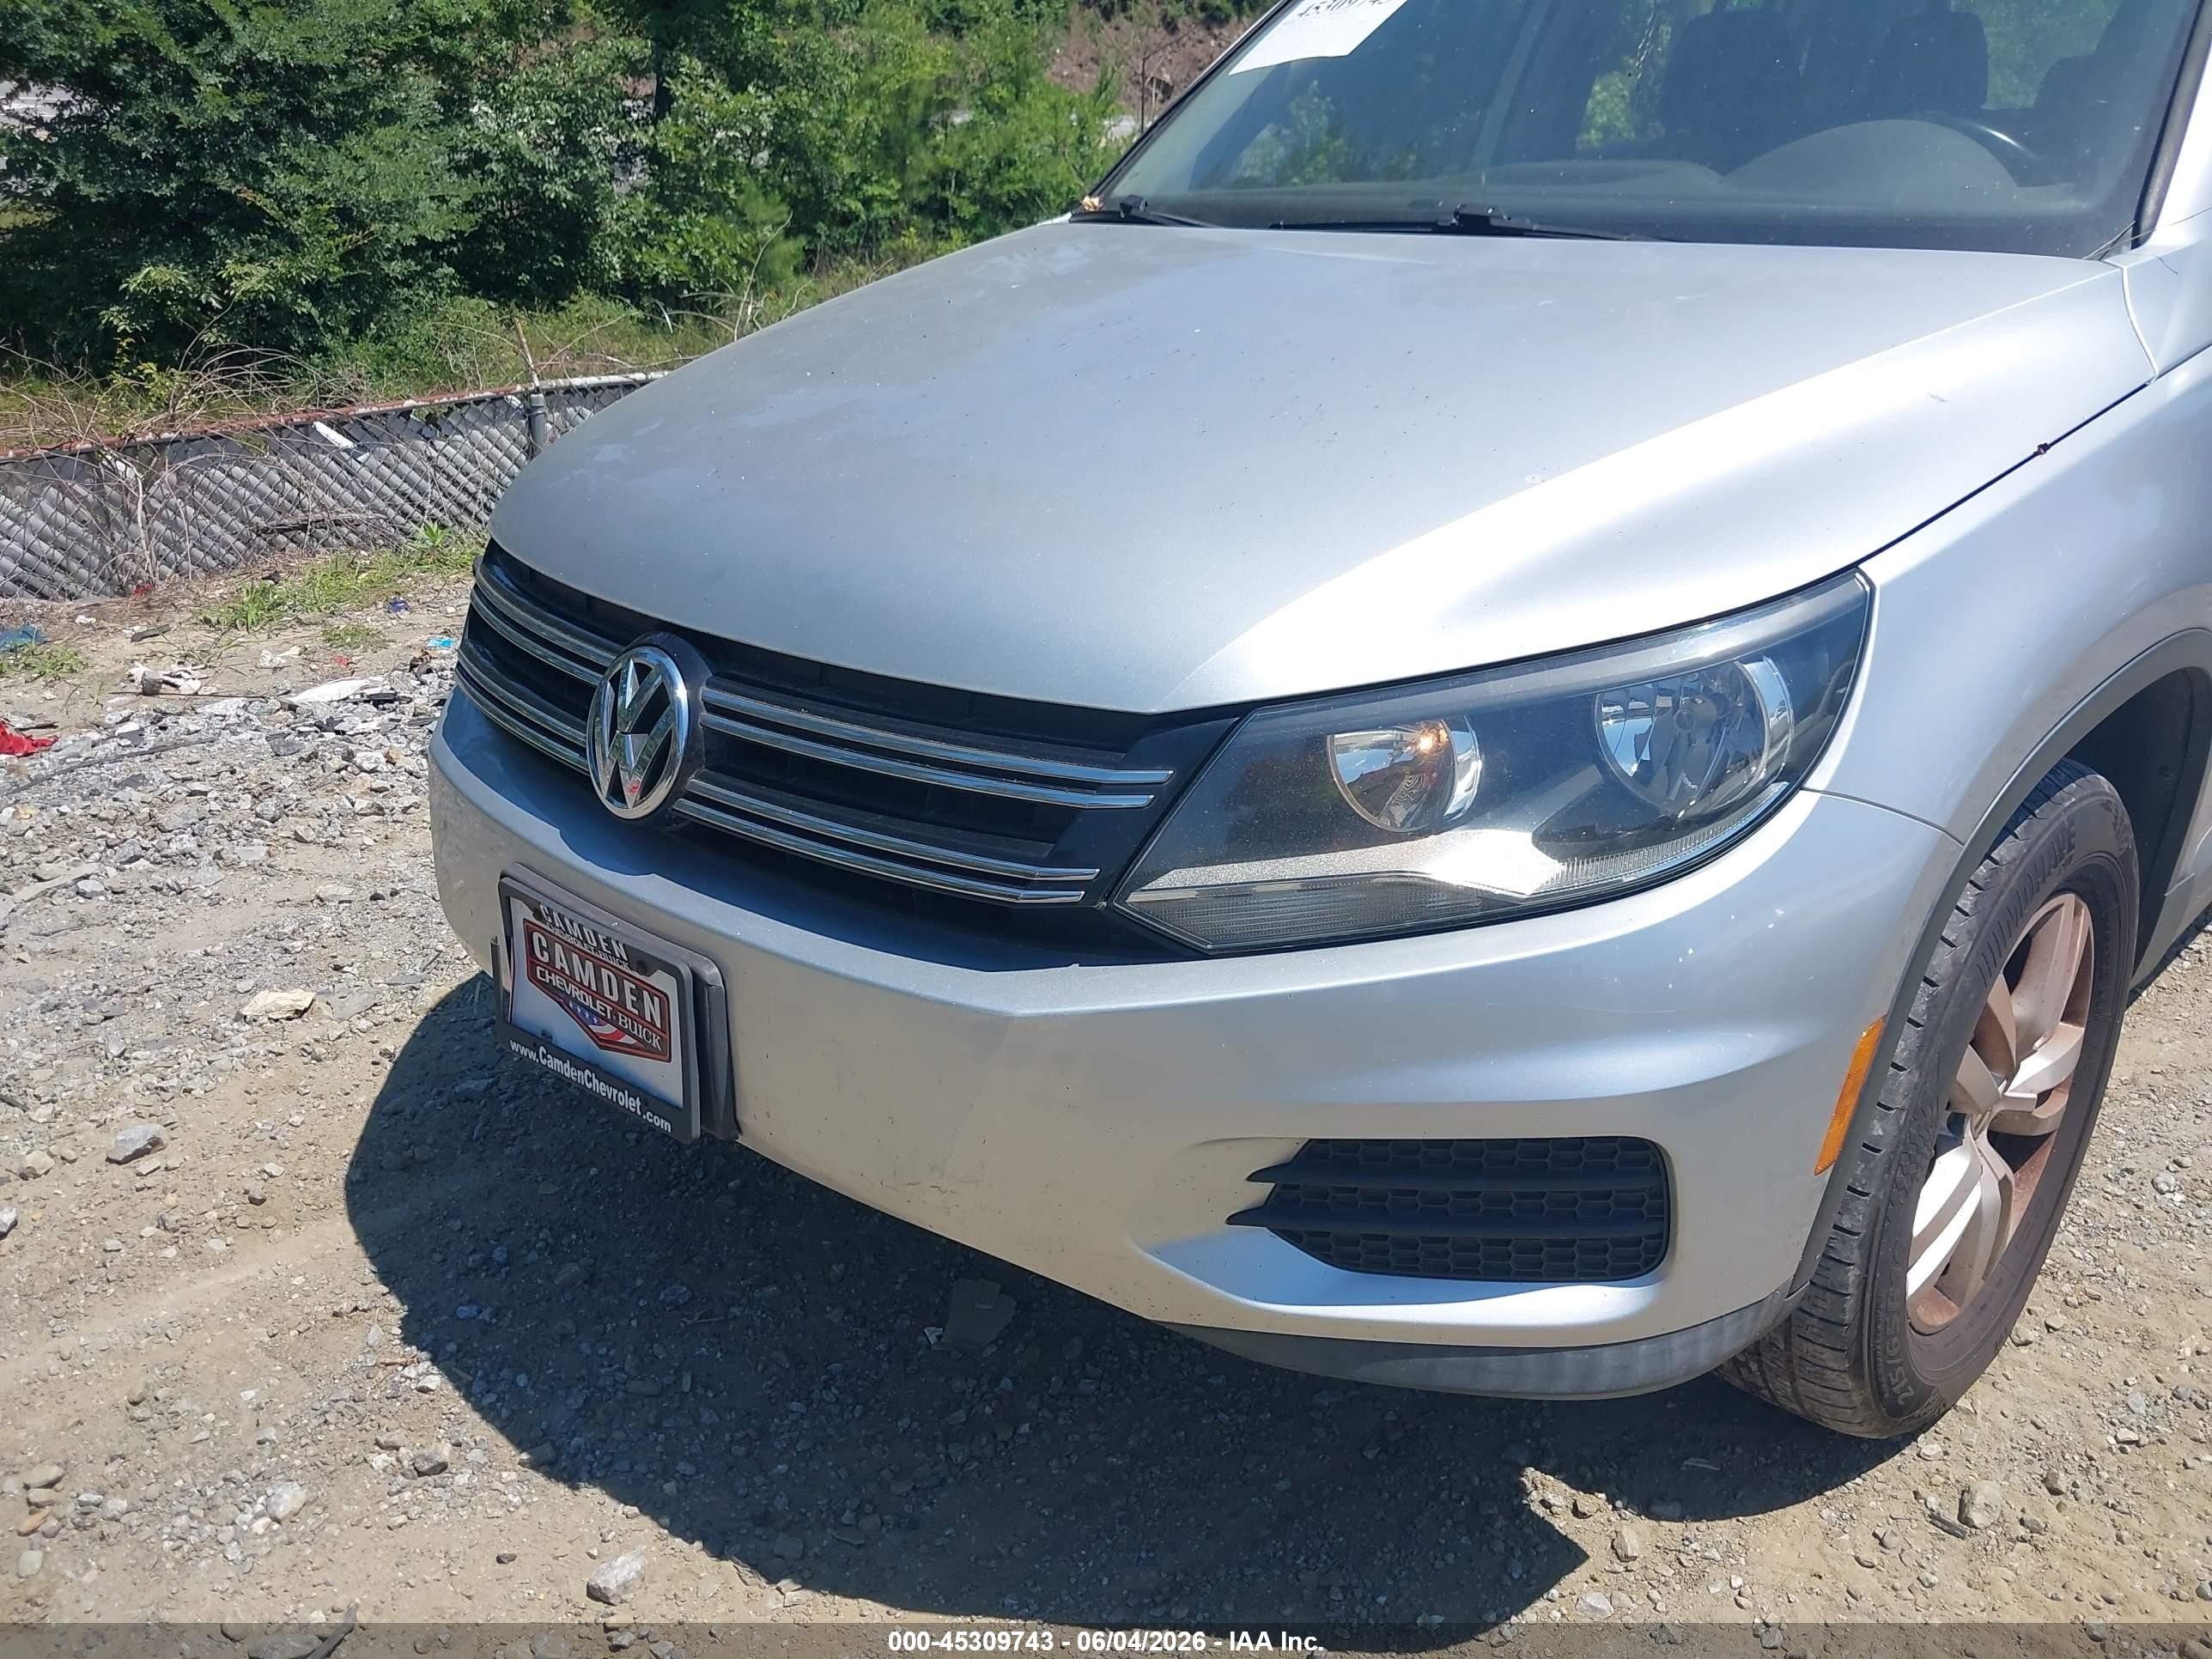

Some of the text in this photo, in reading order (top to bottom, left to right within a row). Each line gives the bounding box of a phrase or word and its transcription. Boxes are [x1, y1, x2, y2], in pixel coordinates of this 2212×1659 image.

[539, 903, 629, 961] CAMDEN
[532, 931, 661, 1029] CAMDEN
[536, 965, 662, 1052] CHEVROLET BUICK
[509, 1037, 672, 1133] www.CamdenChevrolet.com
